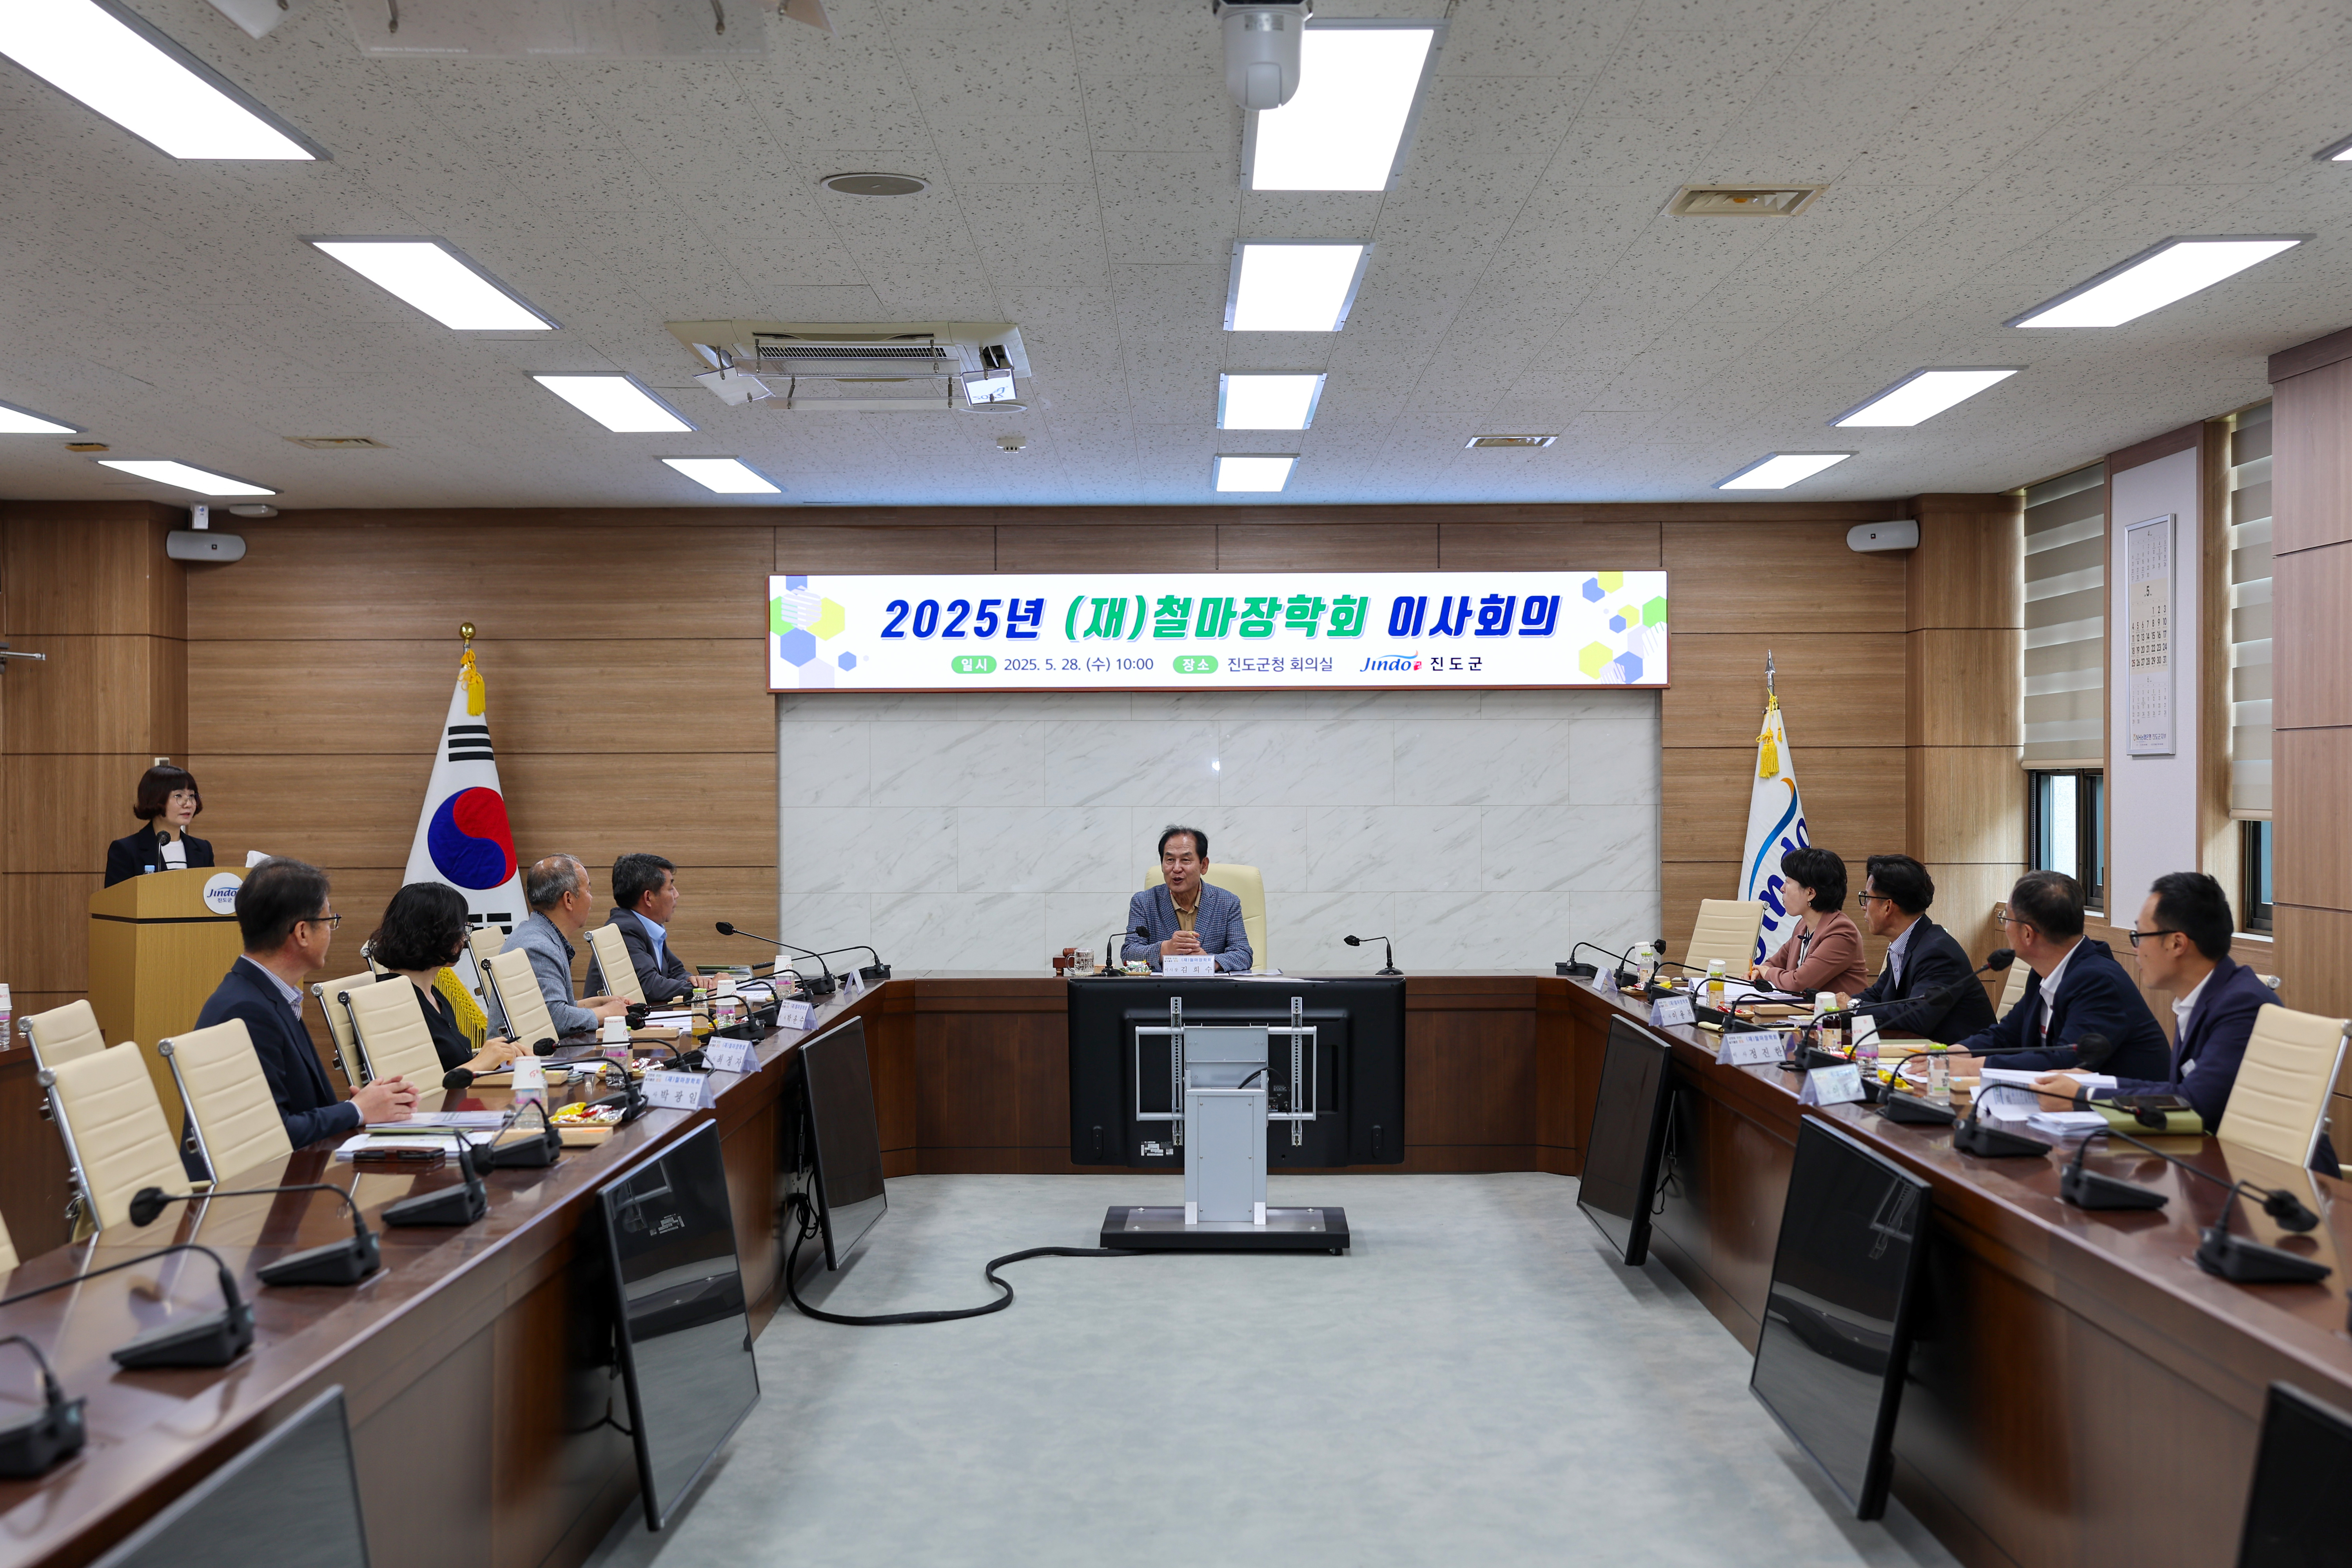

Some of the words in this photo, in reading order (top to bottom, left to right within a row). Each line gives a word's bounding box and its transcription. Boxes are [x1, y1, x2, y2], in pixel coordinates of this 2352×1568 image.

[2146, 586, 2149, 596] 5
[881, 599, 1044, 638] 2025년
[1065, 594, 1368, 640] (재)철마장학회
[1388, 594, 1560, 636] 이사회의
[960, 658, 989, 671] 일시
[1005, 659, 1039, 670] 2025.
[1046, 659, 1056, 670] 5.
[1062, 659, 1080, 670] 28.
[1087, 658, 1110, 671] (수)
[1117, 659, 1153, 670] 10:00
[1182, 658, 1210, 671] 장소
[1229, 658, 1283, 671] 진도군청
[1291, 657, 1332, 671] 회의실
[207, 889, 237, 898] Jindo
